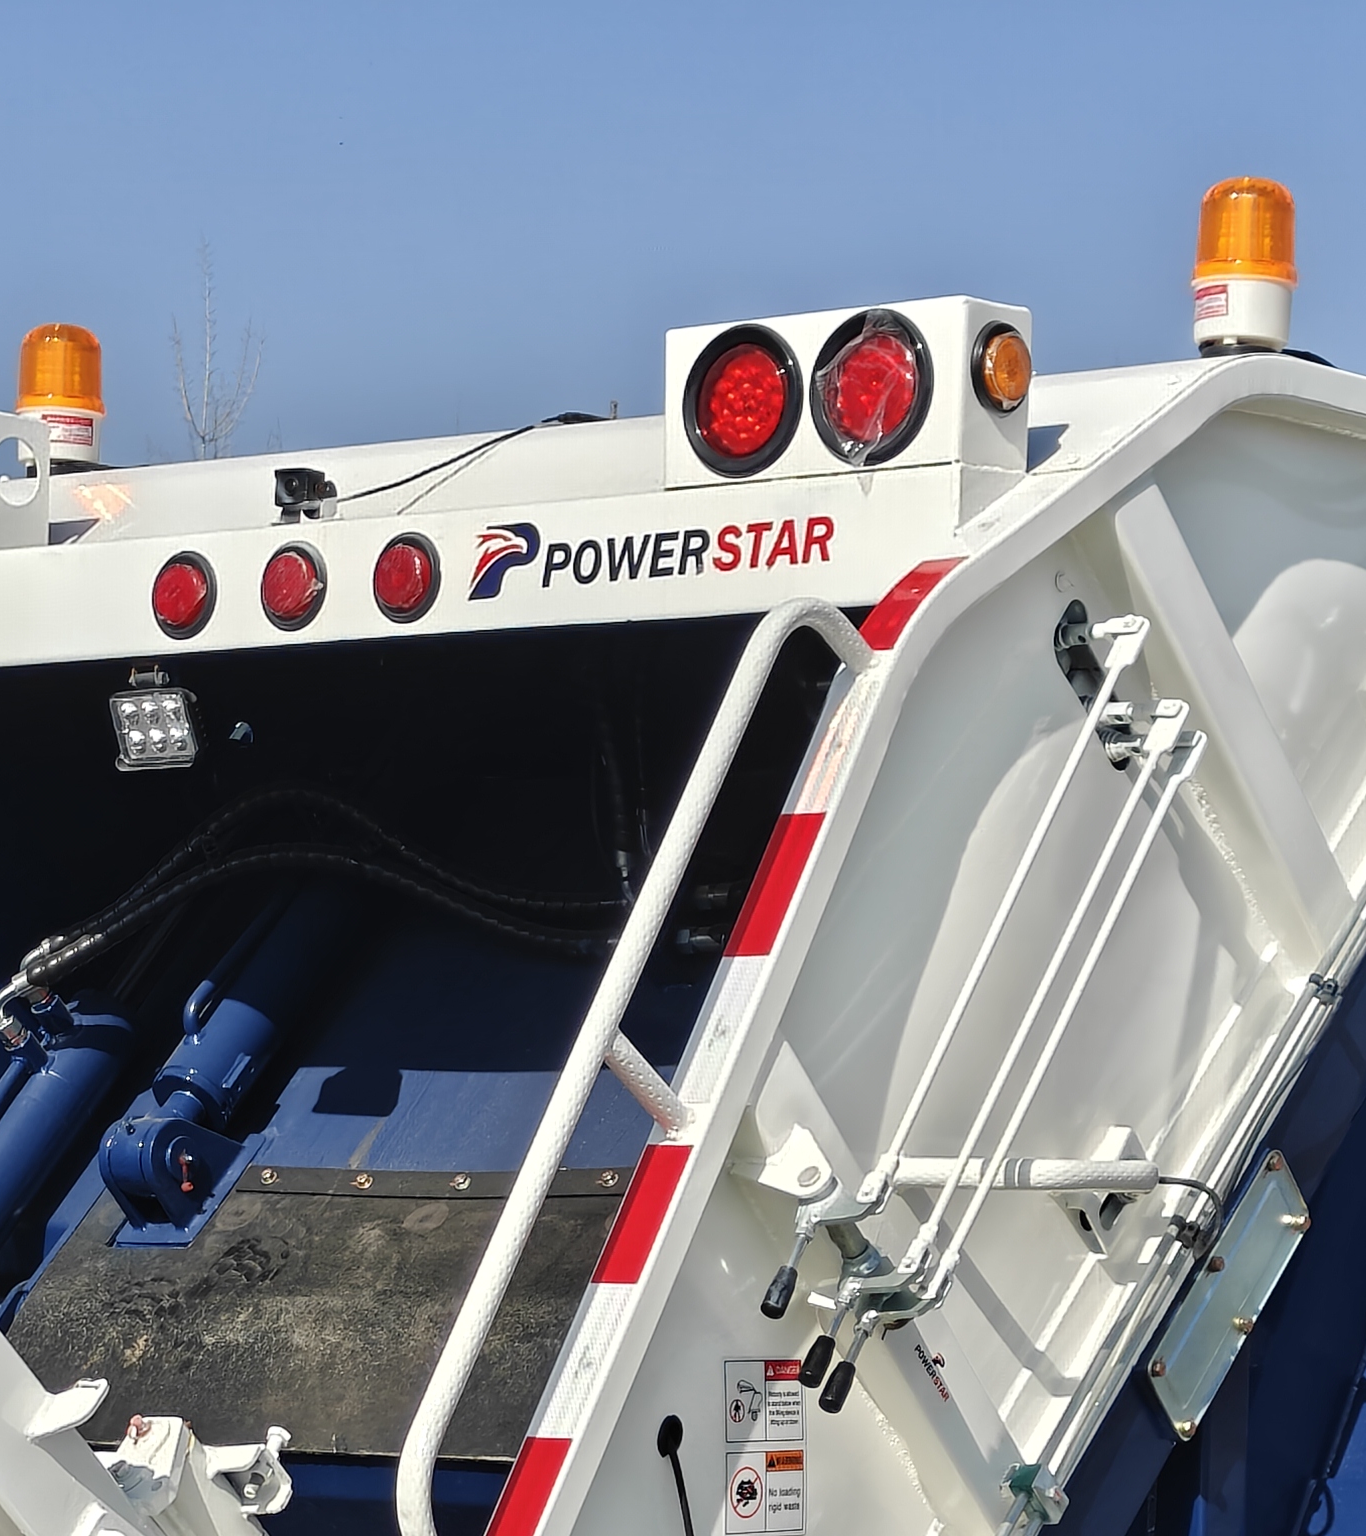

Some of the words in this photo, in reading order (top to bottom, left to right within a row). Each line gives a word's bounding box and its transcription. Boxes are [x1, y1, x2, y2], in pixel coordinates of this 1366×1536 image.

[541, 516, 835, 589] POWERSTAR
[914, 1344, 950, 1402] POWERSTAR
[769, 1488, 777, 1497] No
[779, 1487, 801, 1498] loading
